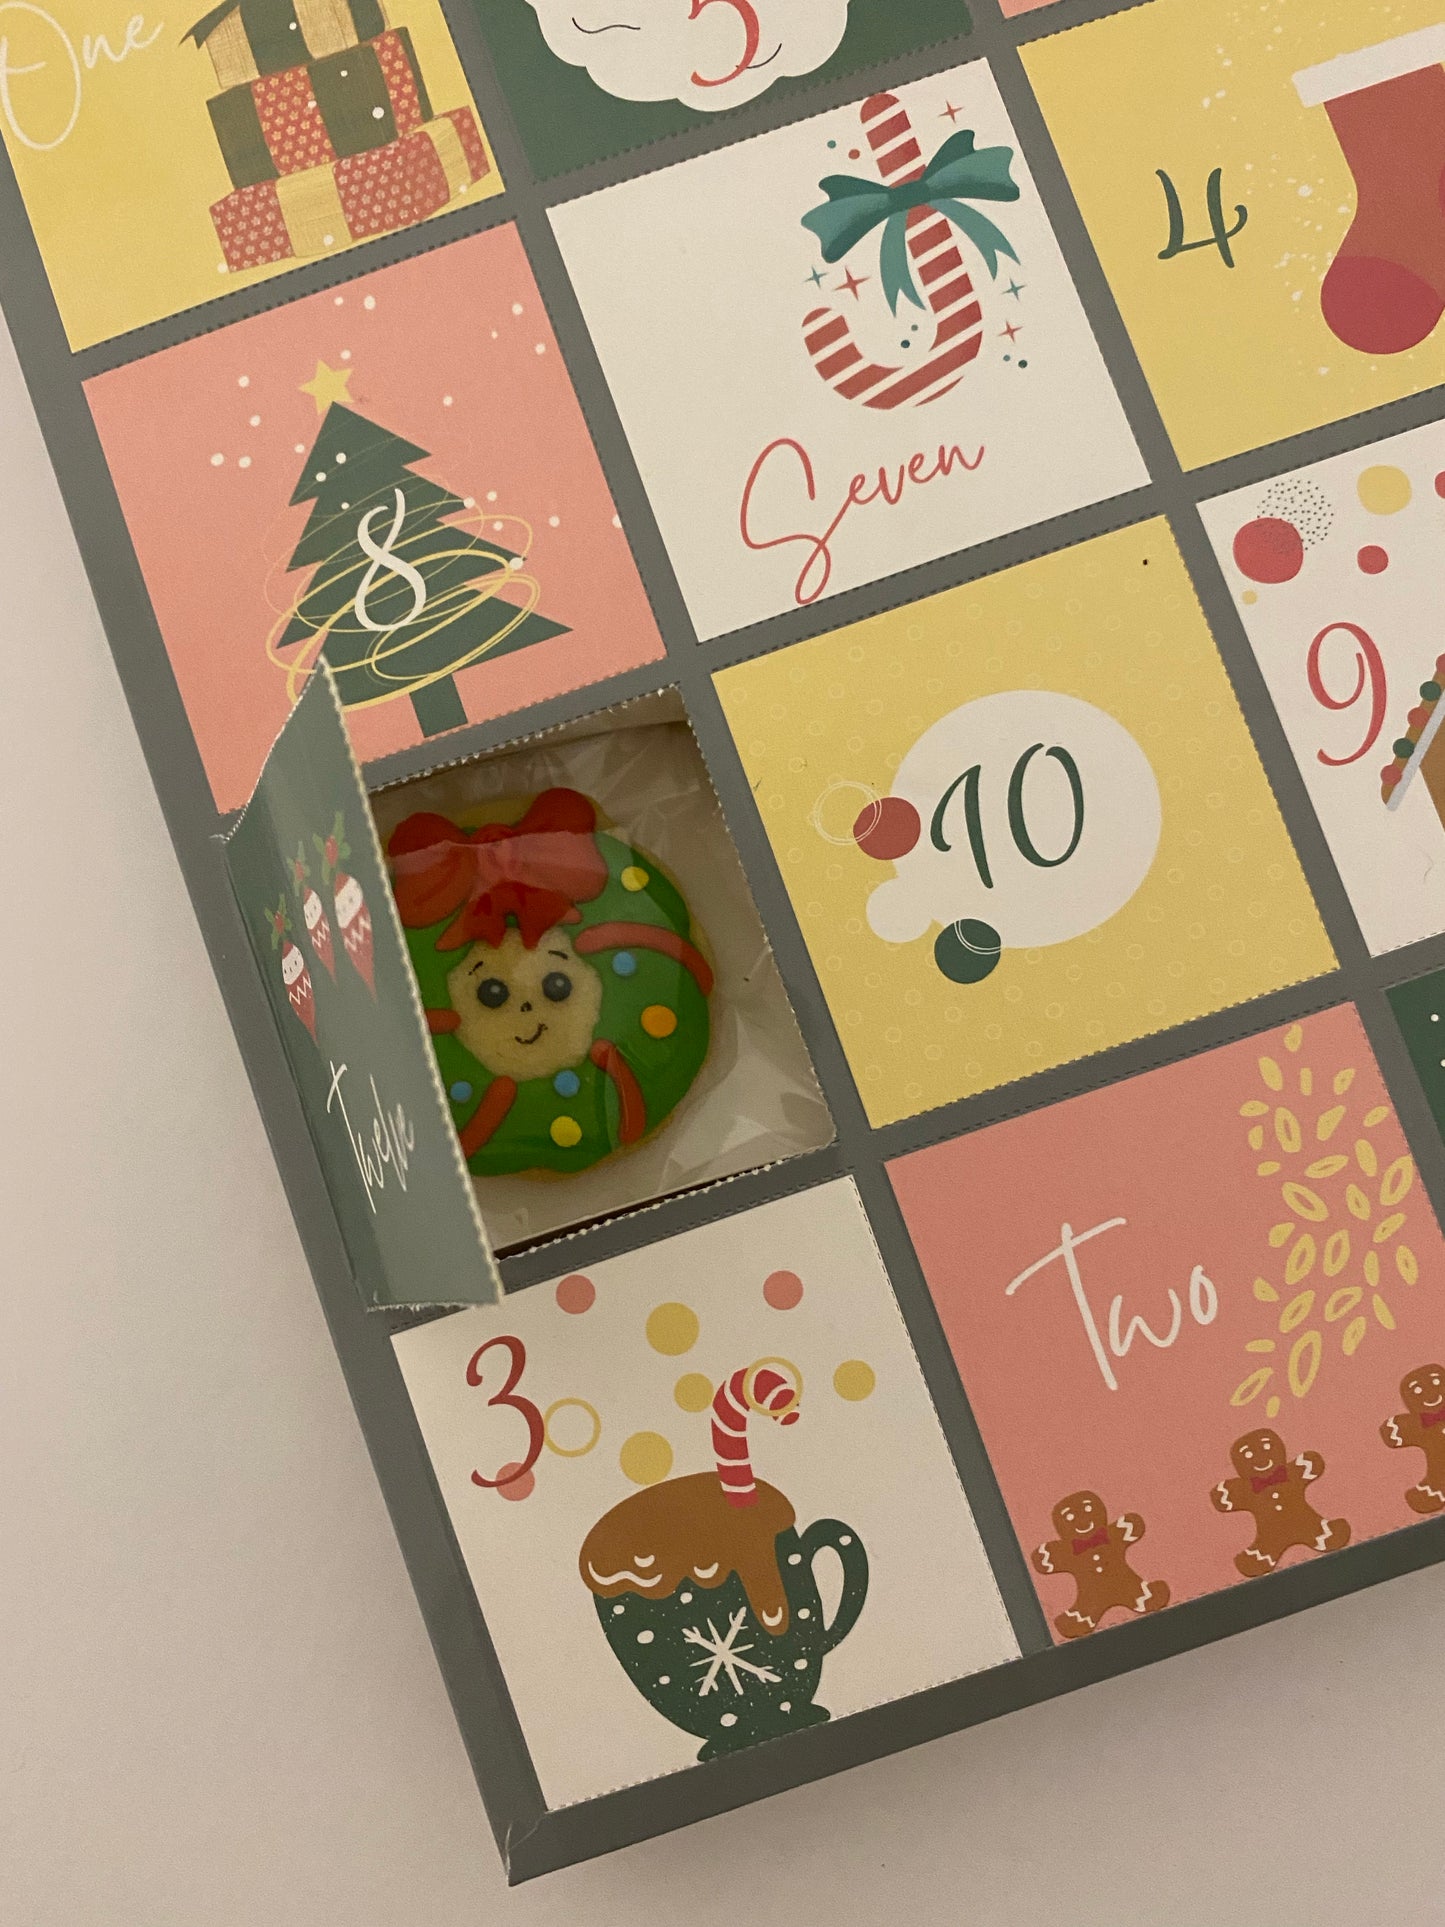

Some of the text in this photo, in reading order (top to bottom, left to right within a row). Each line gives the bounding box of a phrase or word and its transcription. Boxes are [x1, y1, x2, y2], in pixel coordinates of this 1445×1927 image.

[0, 1, 164, 150] One
[688, 0, 760, 87] 5
[1157, 167, 1249, 268] 4
[354, 488, 427, 630] 8
[740, 438, 985, 605] Seven
[1307, 622, 1387, 766] 9
[930, 743, 1085, 889] 10
[326, 1060, 415, 1214] Twelve
[1006, 1217, 1218, 1391] Two
[466, 1335, 544, 1488] 3
